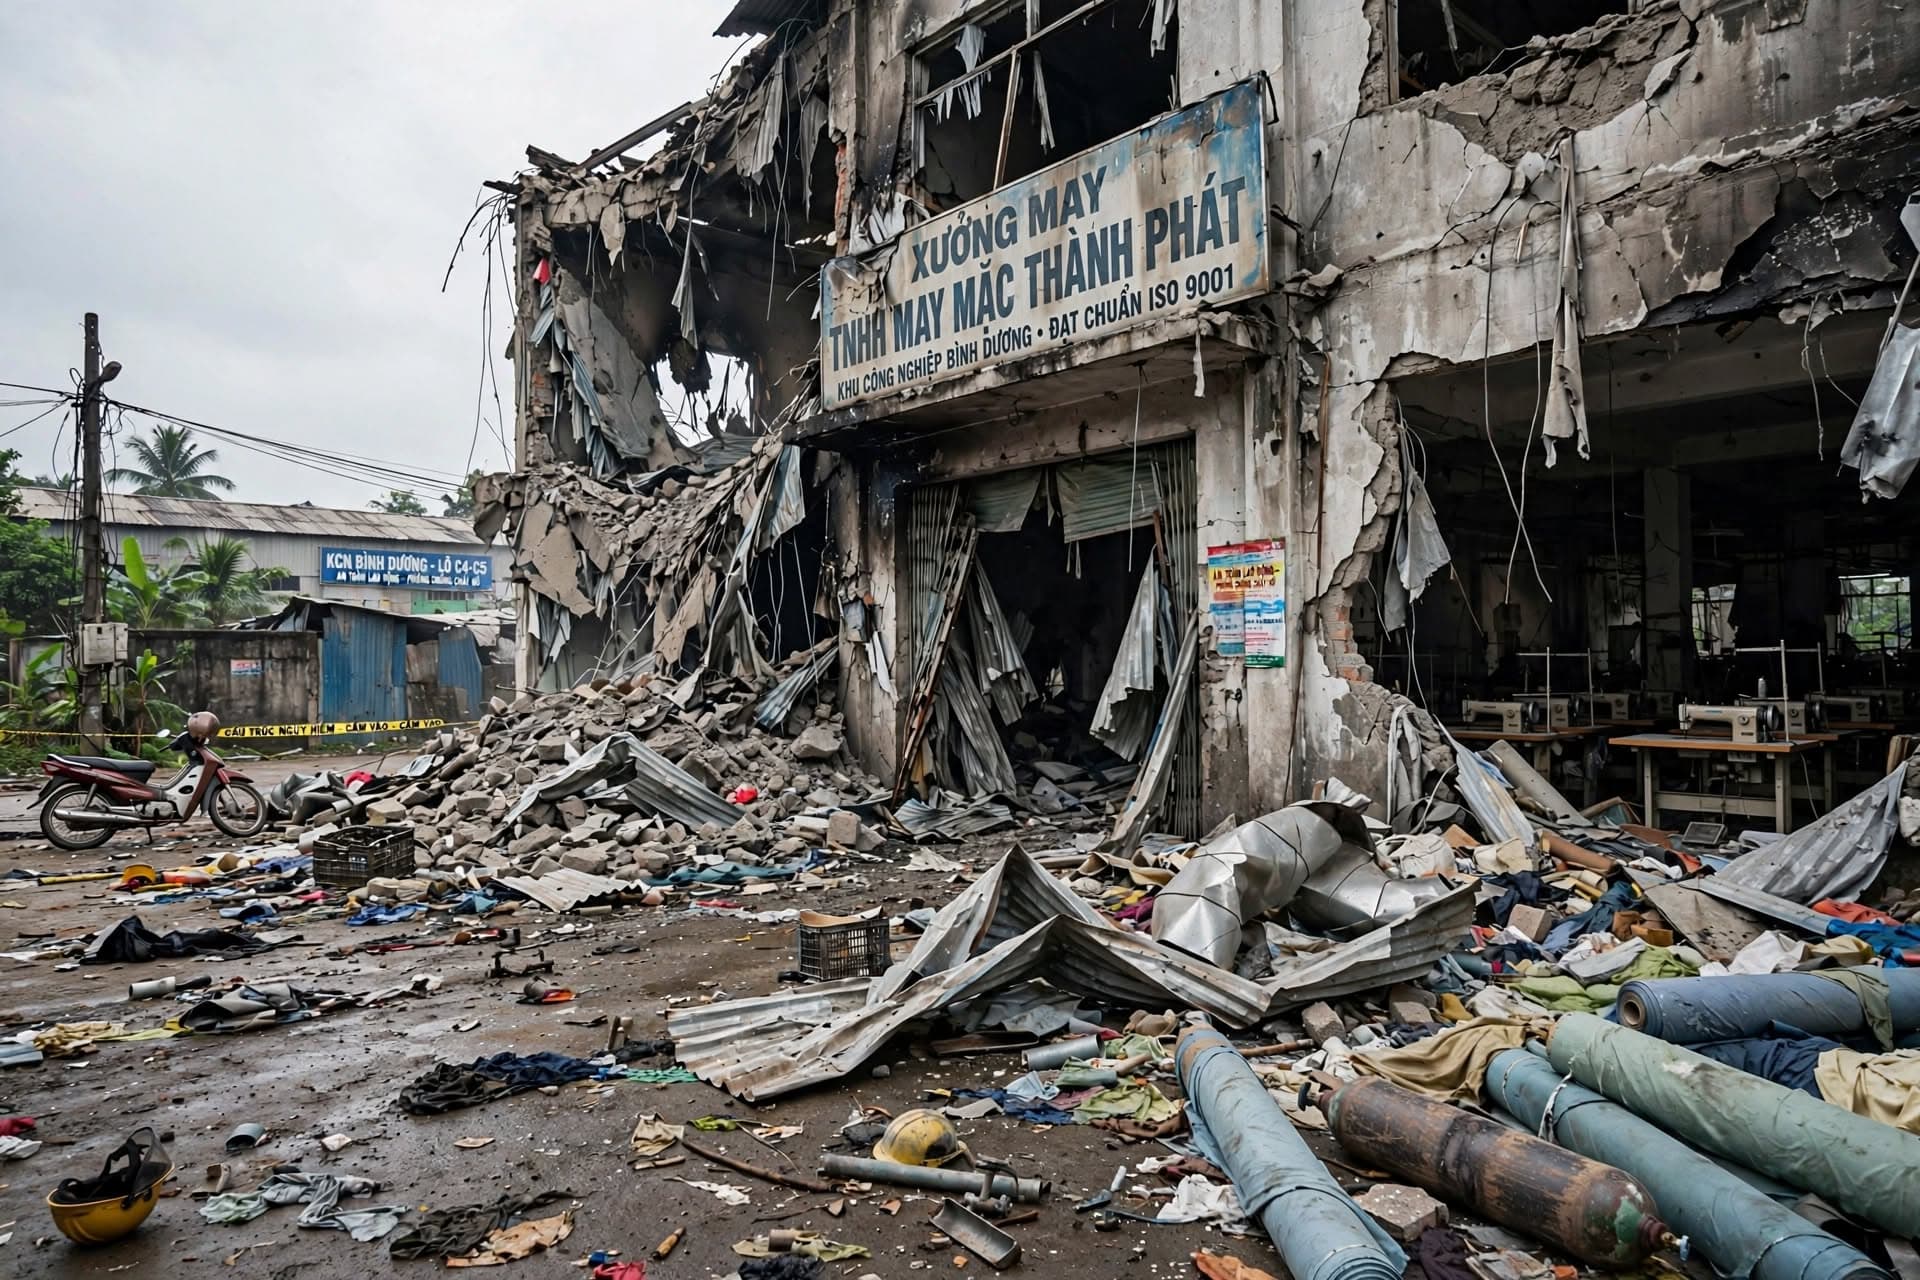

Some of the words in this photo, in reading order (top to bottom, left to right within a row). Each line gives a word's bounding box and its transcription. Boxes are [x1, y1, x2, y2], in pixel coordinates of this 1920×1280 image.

[829, 307, 887, 372] TNHH
[893, 287, 944, 352] MAY
[953, 258, 1014, 334] MẶC
[1024, 217, 1133, 309] THÀNH
[1145, 171, 1245, 272] PHÁT
[911, 205, 1018, 283] XƯỞNG
[1028, 165, 1107, 238] MAY
[837, 376, 859, 401] KHU
[863, 366, 894, 394] CÔNG
[898, 349, 942, 385] NGHIỆP
[947, 341, 978, 370] BÌNH
[983, 325, 1032, 359] DƯƠNG
[1049, 310, 1079, 344] ĐẠT
[1084, 283, 1142, 330] CHUẨN
[1149, 279, 1179, 311] ISO
[1186, 263, 1233, 300] 9001
[326, 552, 353, 569] KCN
[355, 551, 385, 571] BÌNH
[388, 553, 428, 573] DƯƠNG
[455, 559, 488, 575] C4-C5
[279, 725, 307, 736] NGUY
